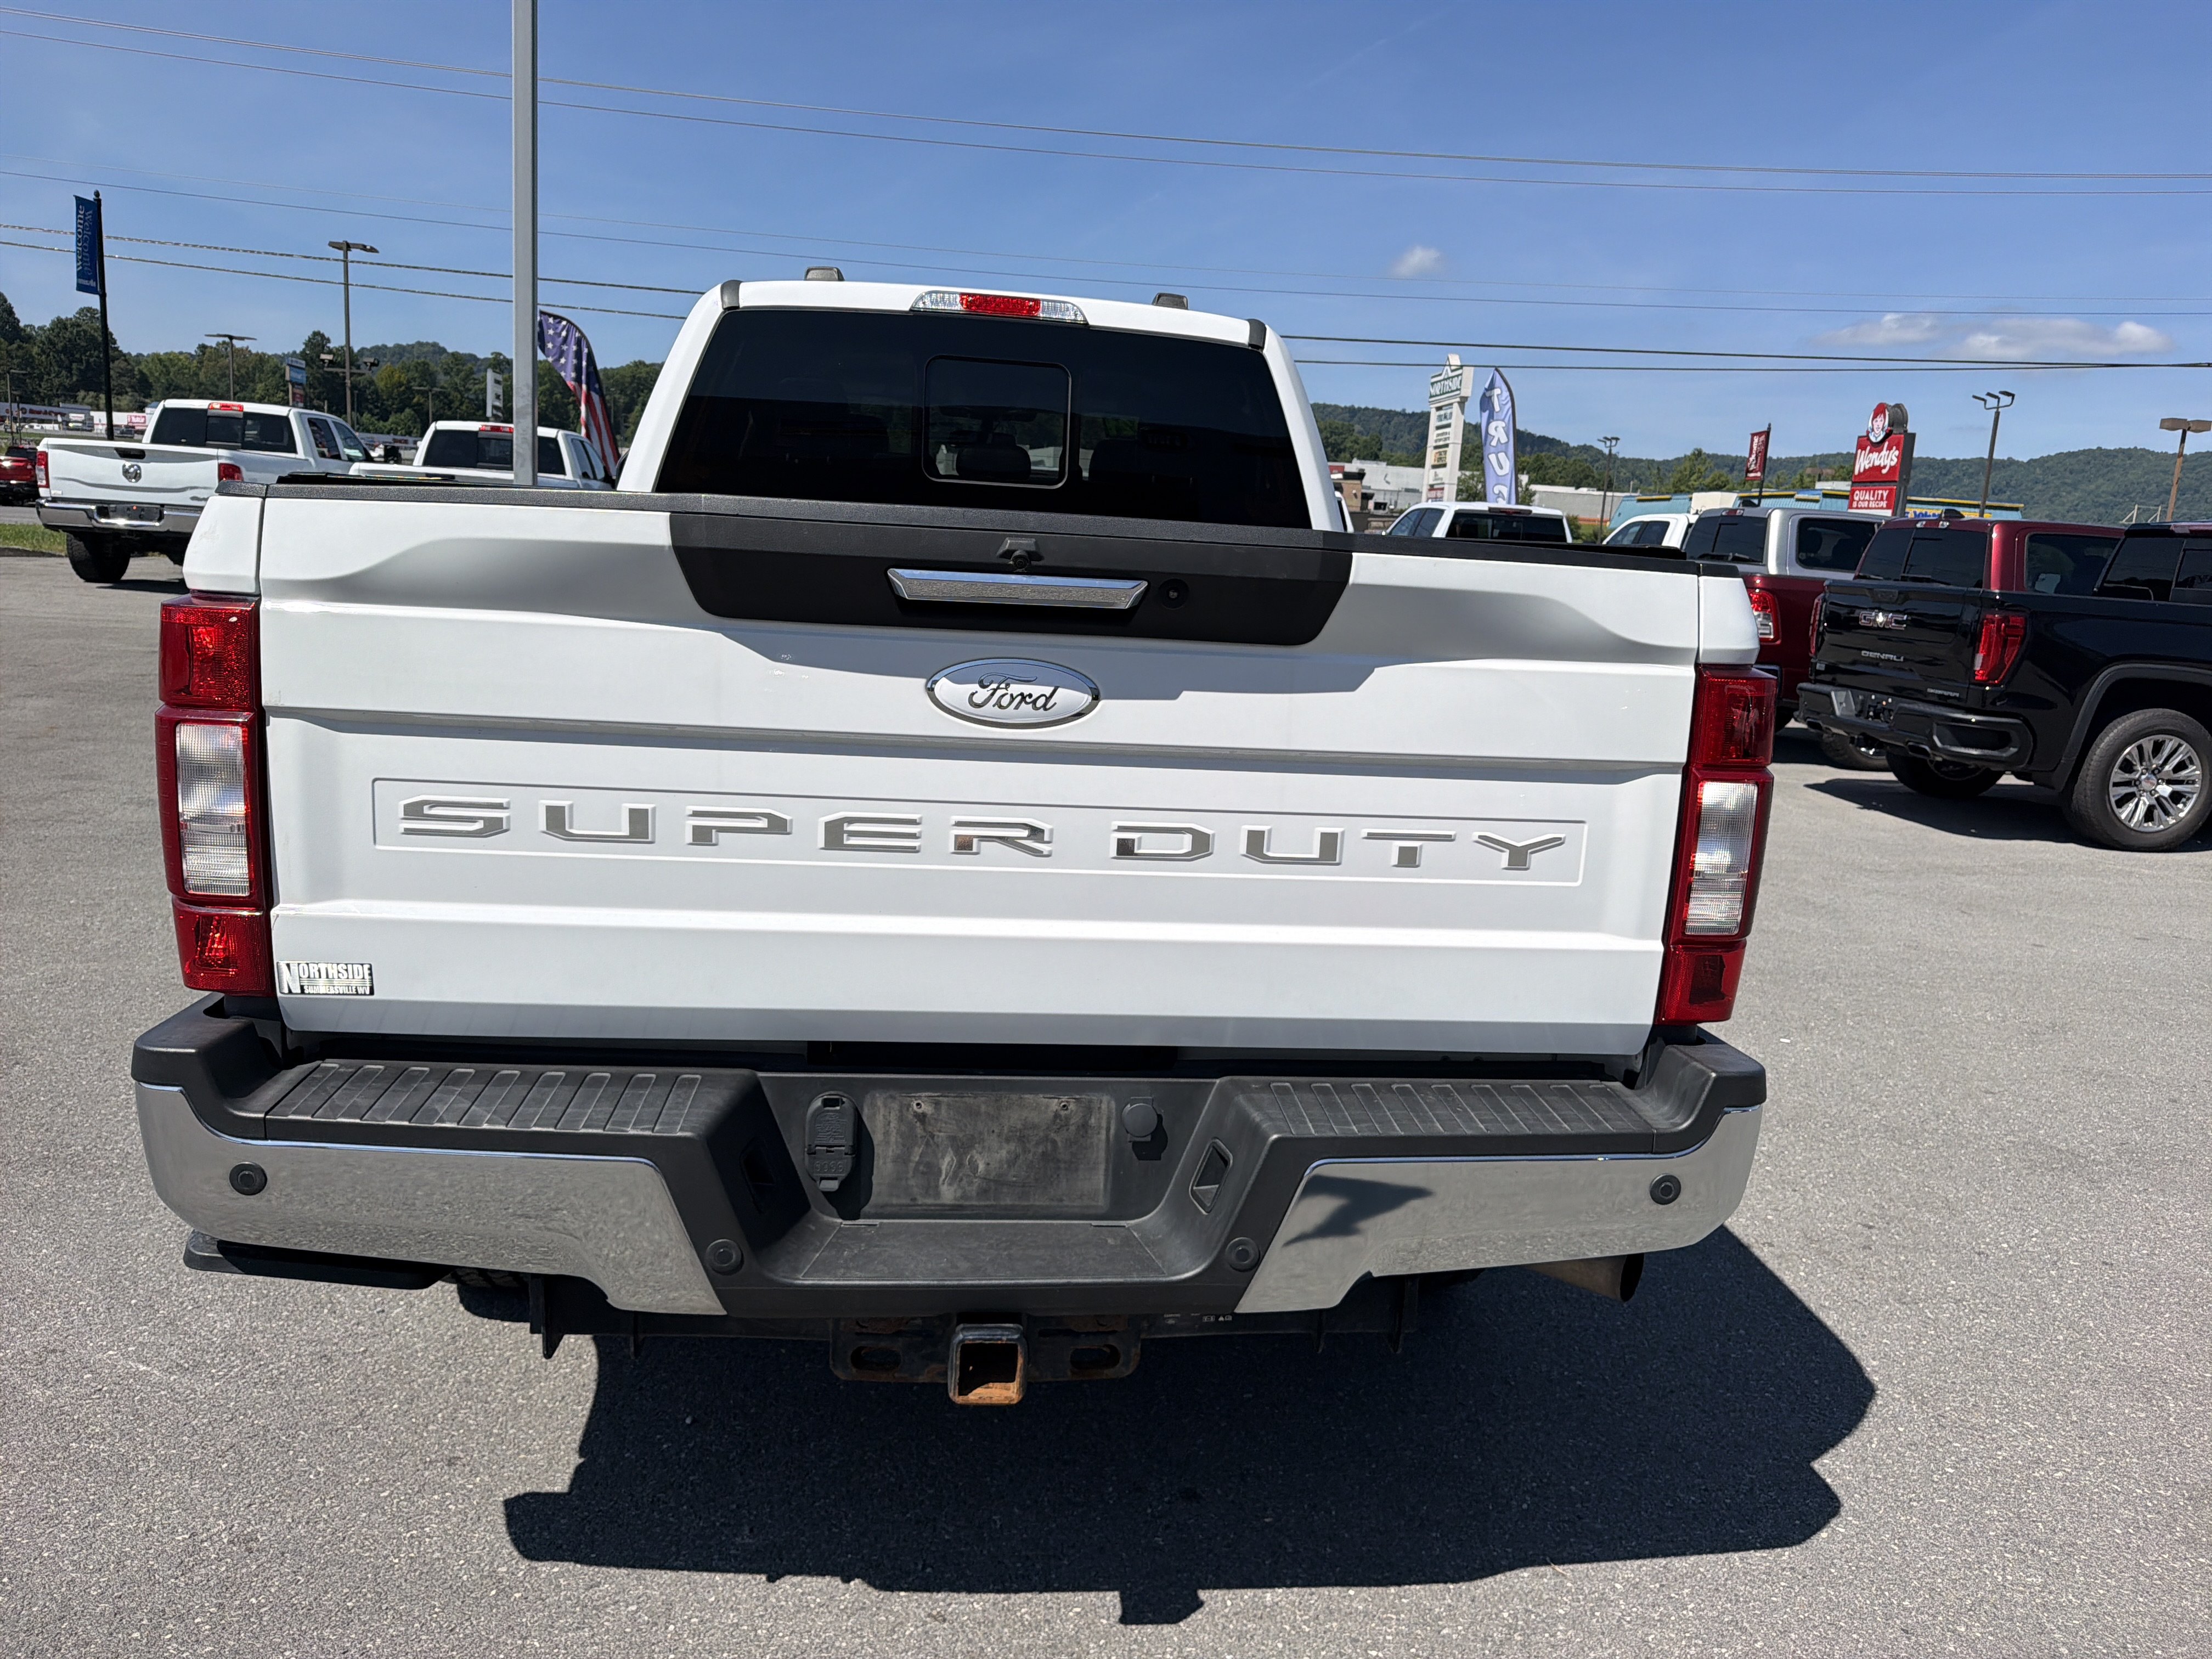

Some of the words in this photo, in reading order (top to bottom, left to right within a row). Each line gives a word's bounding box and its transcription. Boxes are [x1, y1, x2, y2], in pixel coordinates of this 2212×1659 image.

[1854, 441, 1899, 476] Wendy's
[1853, 489, 1889, 501] QUALITY
[1859, 611, 1907, 630] GMC
[1861, 650, 1904, 662] DENALI
[968, 672, 1060, 712] Ford
[398, 794, 1053, 857] SUPER
[1110, 821, 1566, 871] DUTY
[276, 962, 373, 994] NORTHSIDE
[357, 986, 370, 995] WV
